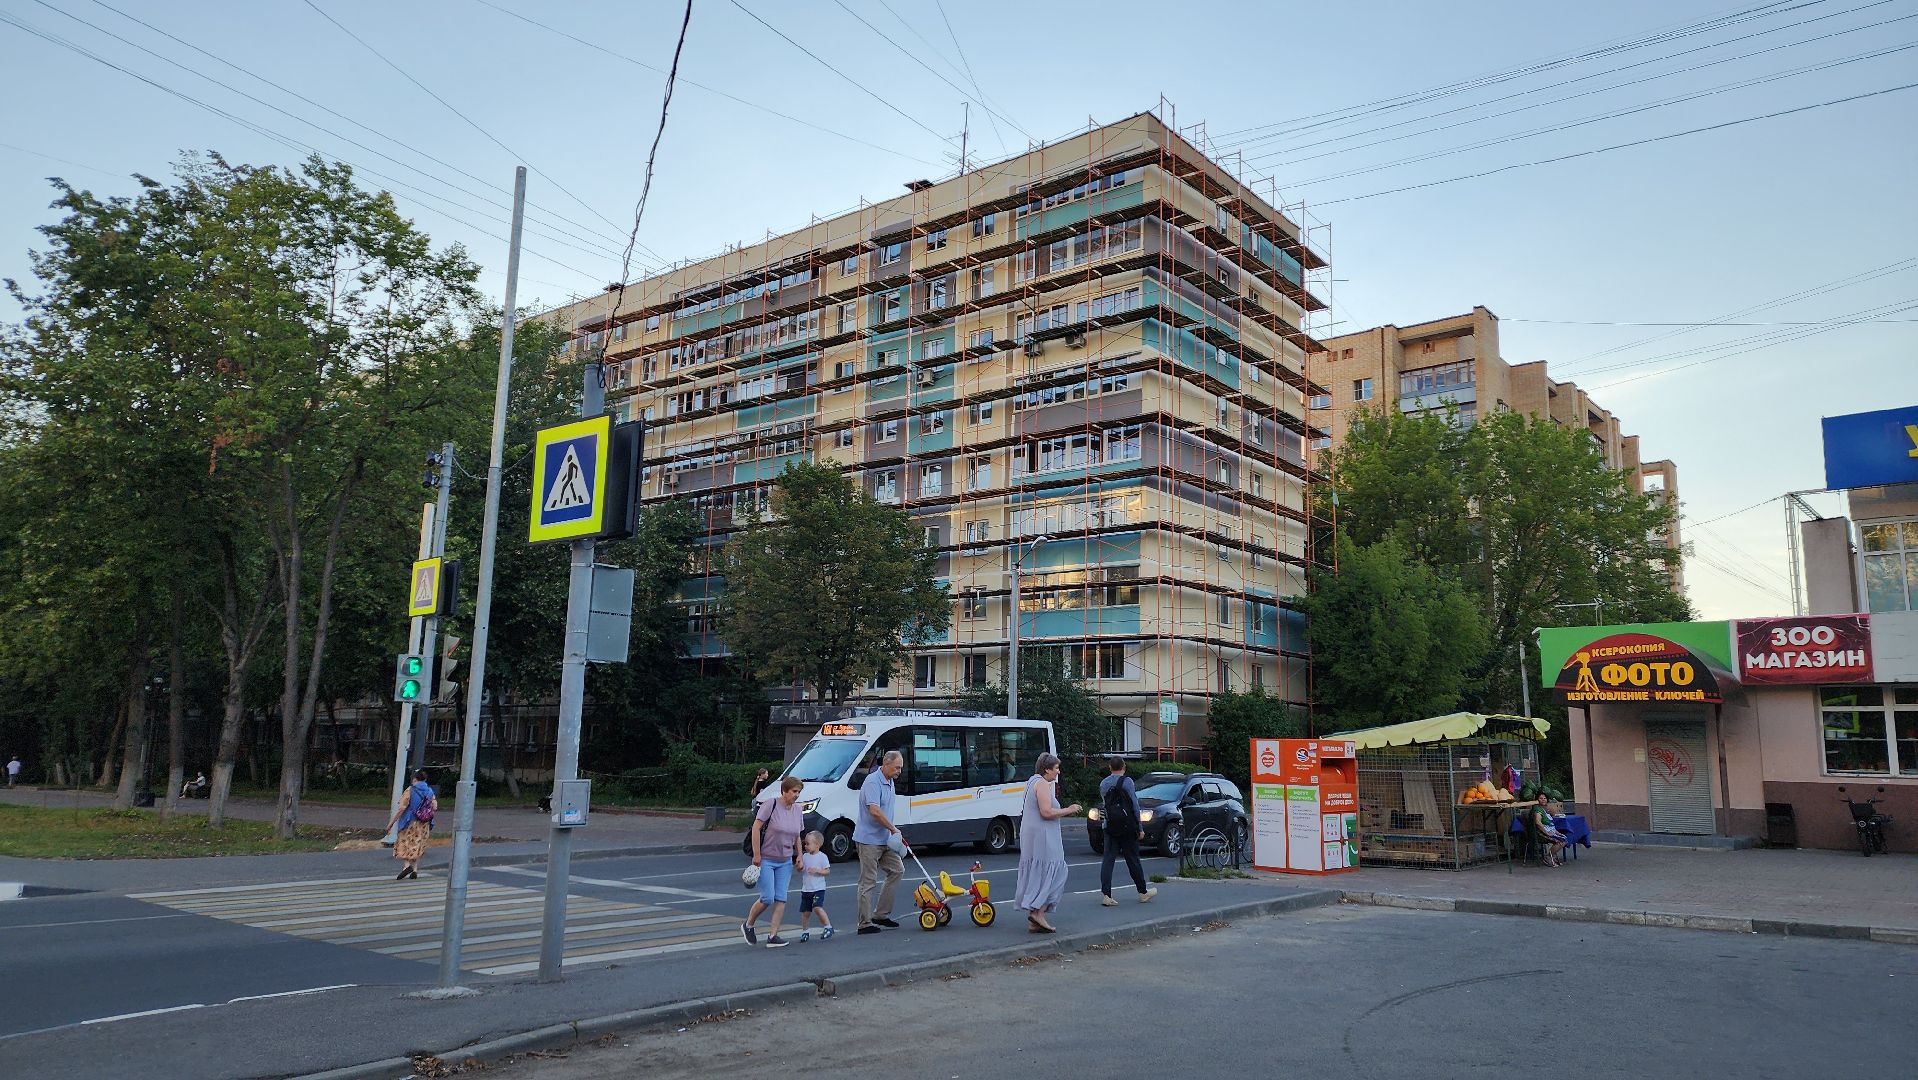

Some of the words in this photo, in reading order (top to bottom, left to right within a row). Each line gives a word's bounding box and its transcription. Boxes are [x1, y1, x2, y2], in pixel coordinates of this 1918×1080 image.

[1771, 626, 1835, 647] ЗОО
[1592, 643, 1666, 657] КСЕРОКОПИЯ
[1745, 649, 1866, 669] МАГАЗИН
[1601, 661, 1695, 687] ФОТО
[1567, 691, 1650, 701] ИЗГОТОВЛЕНИЕ
[1655, 689, 1705, 700] КЛЮЧЕЙ
